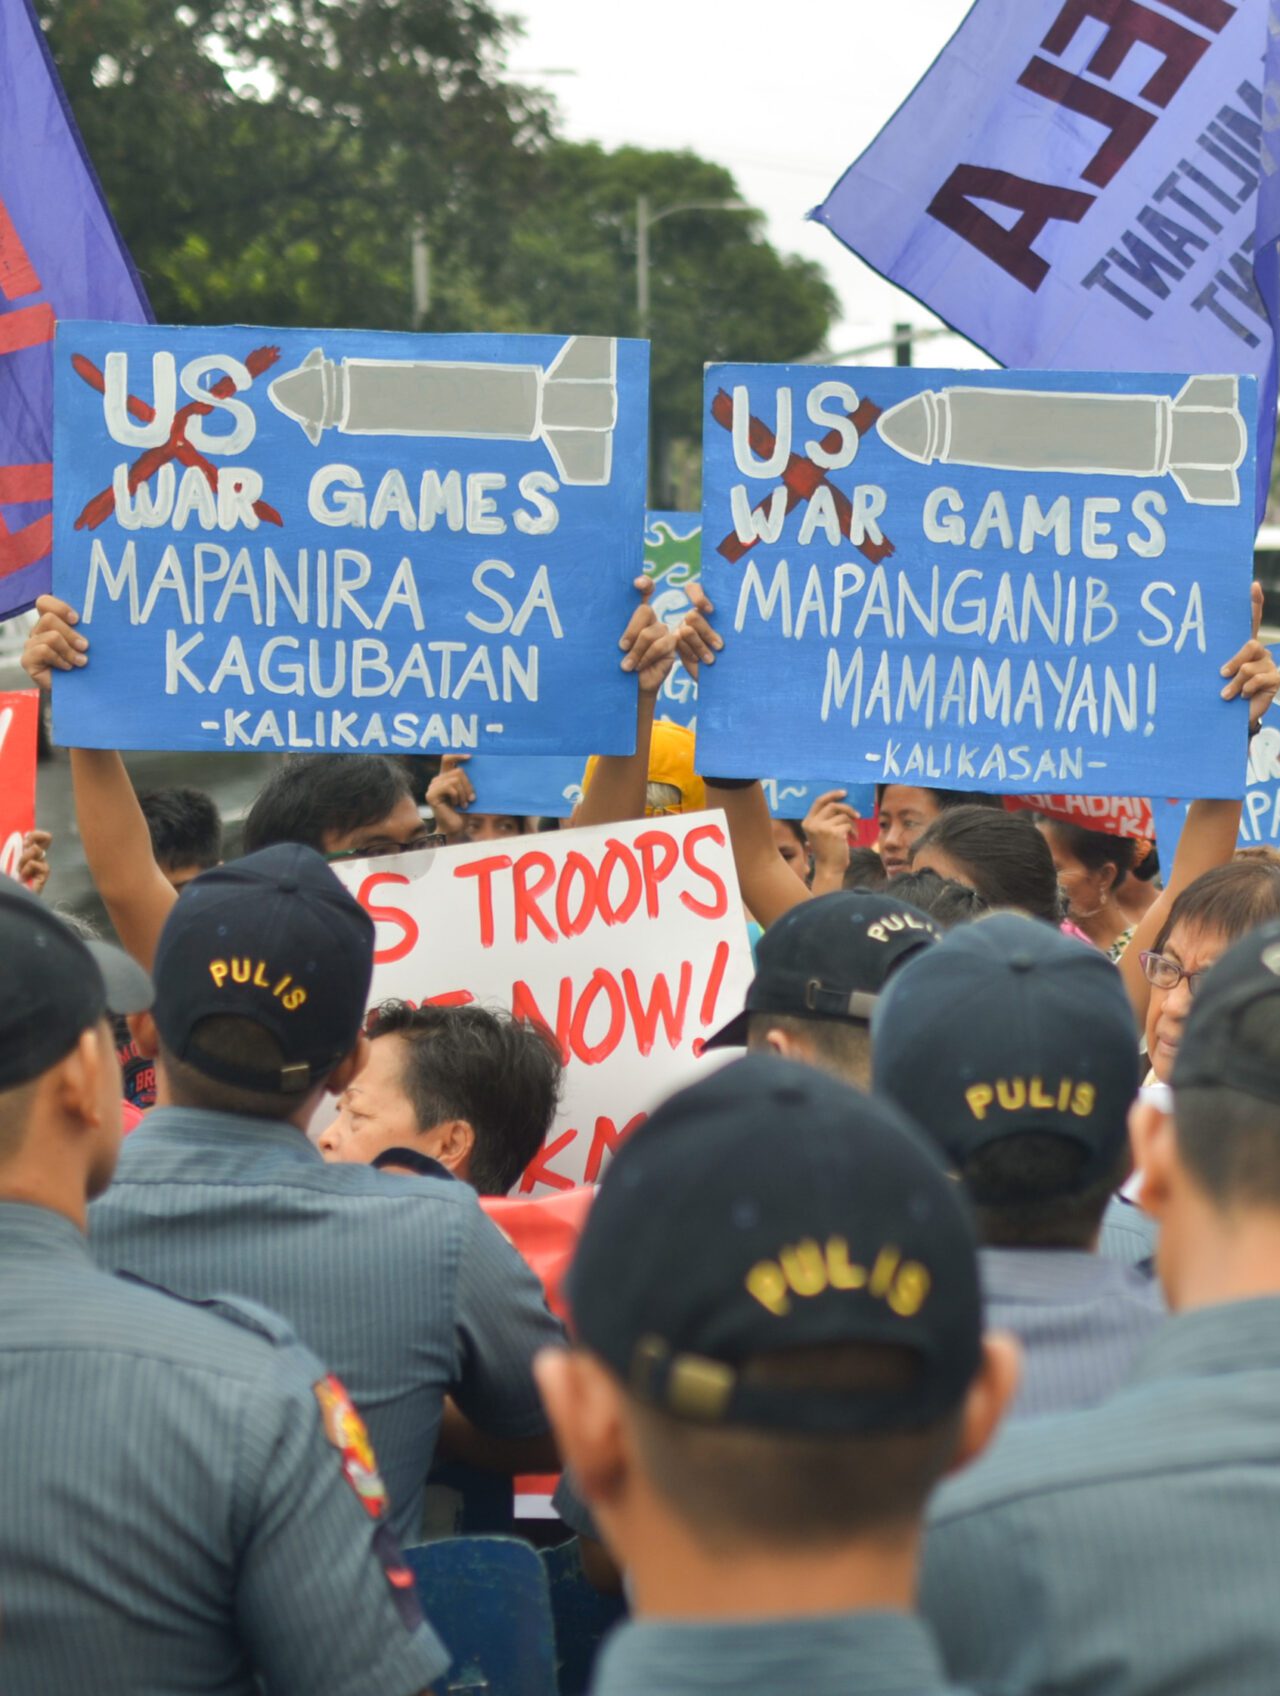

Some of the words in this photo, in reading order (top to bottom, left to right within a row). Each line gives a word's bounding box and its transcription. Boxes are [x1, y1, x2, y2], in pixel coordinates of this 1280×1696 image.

[103, 351, 256, 455] US
[731, 381, 860, 479] US
[113, 463, 264, 532] WAR
[307, 464, 559, 535] GAMES
[730, 485, 886, 547] WAR
[923, 486, 1167, 560] GAMES
[82, 539, 425, 631] MAPANIRA
[465, 559, 563, 638] SA
[734, 560, 1117, 646] MAPANGANIB
[1137, 581, 1206, 653] SA
[165, 630, 539, 702] KAGUBATAN
[820, 648, 1157, 737] MAMAMAYAN!
[357, 873, 419, 964] S
[454, 824, 728, 949] TROOPS
[210, 957, 306, 1011] PULIS
[512, 941, 729, 1066] NOW!
[965, 1077, 1095, 1120] PULIS
[745, 1234, 932, 1317] PULIS
